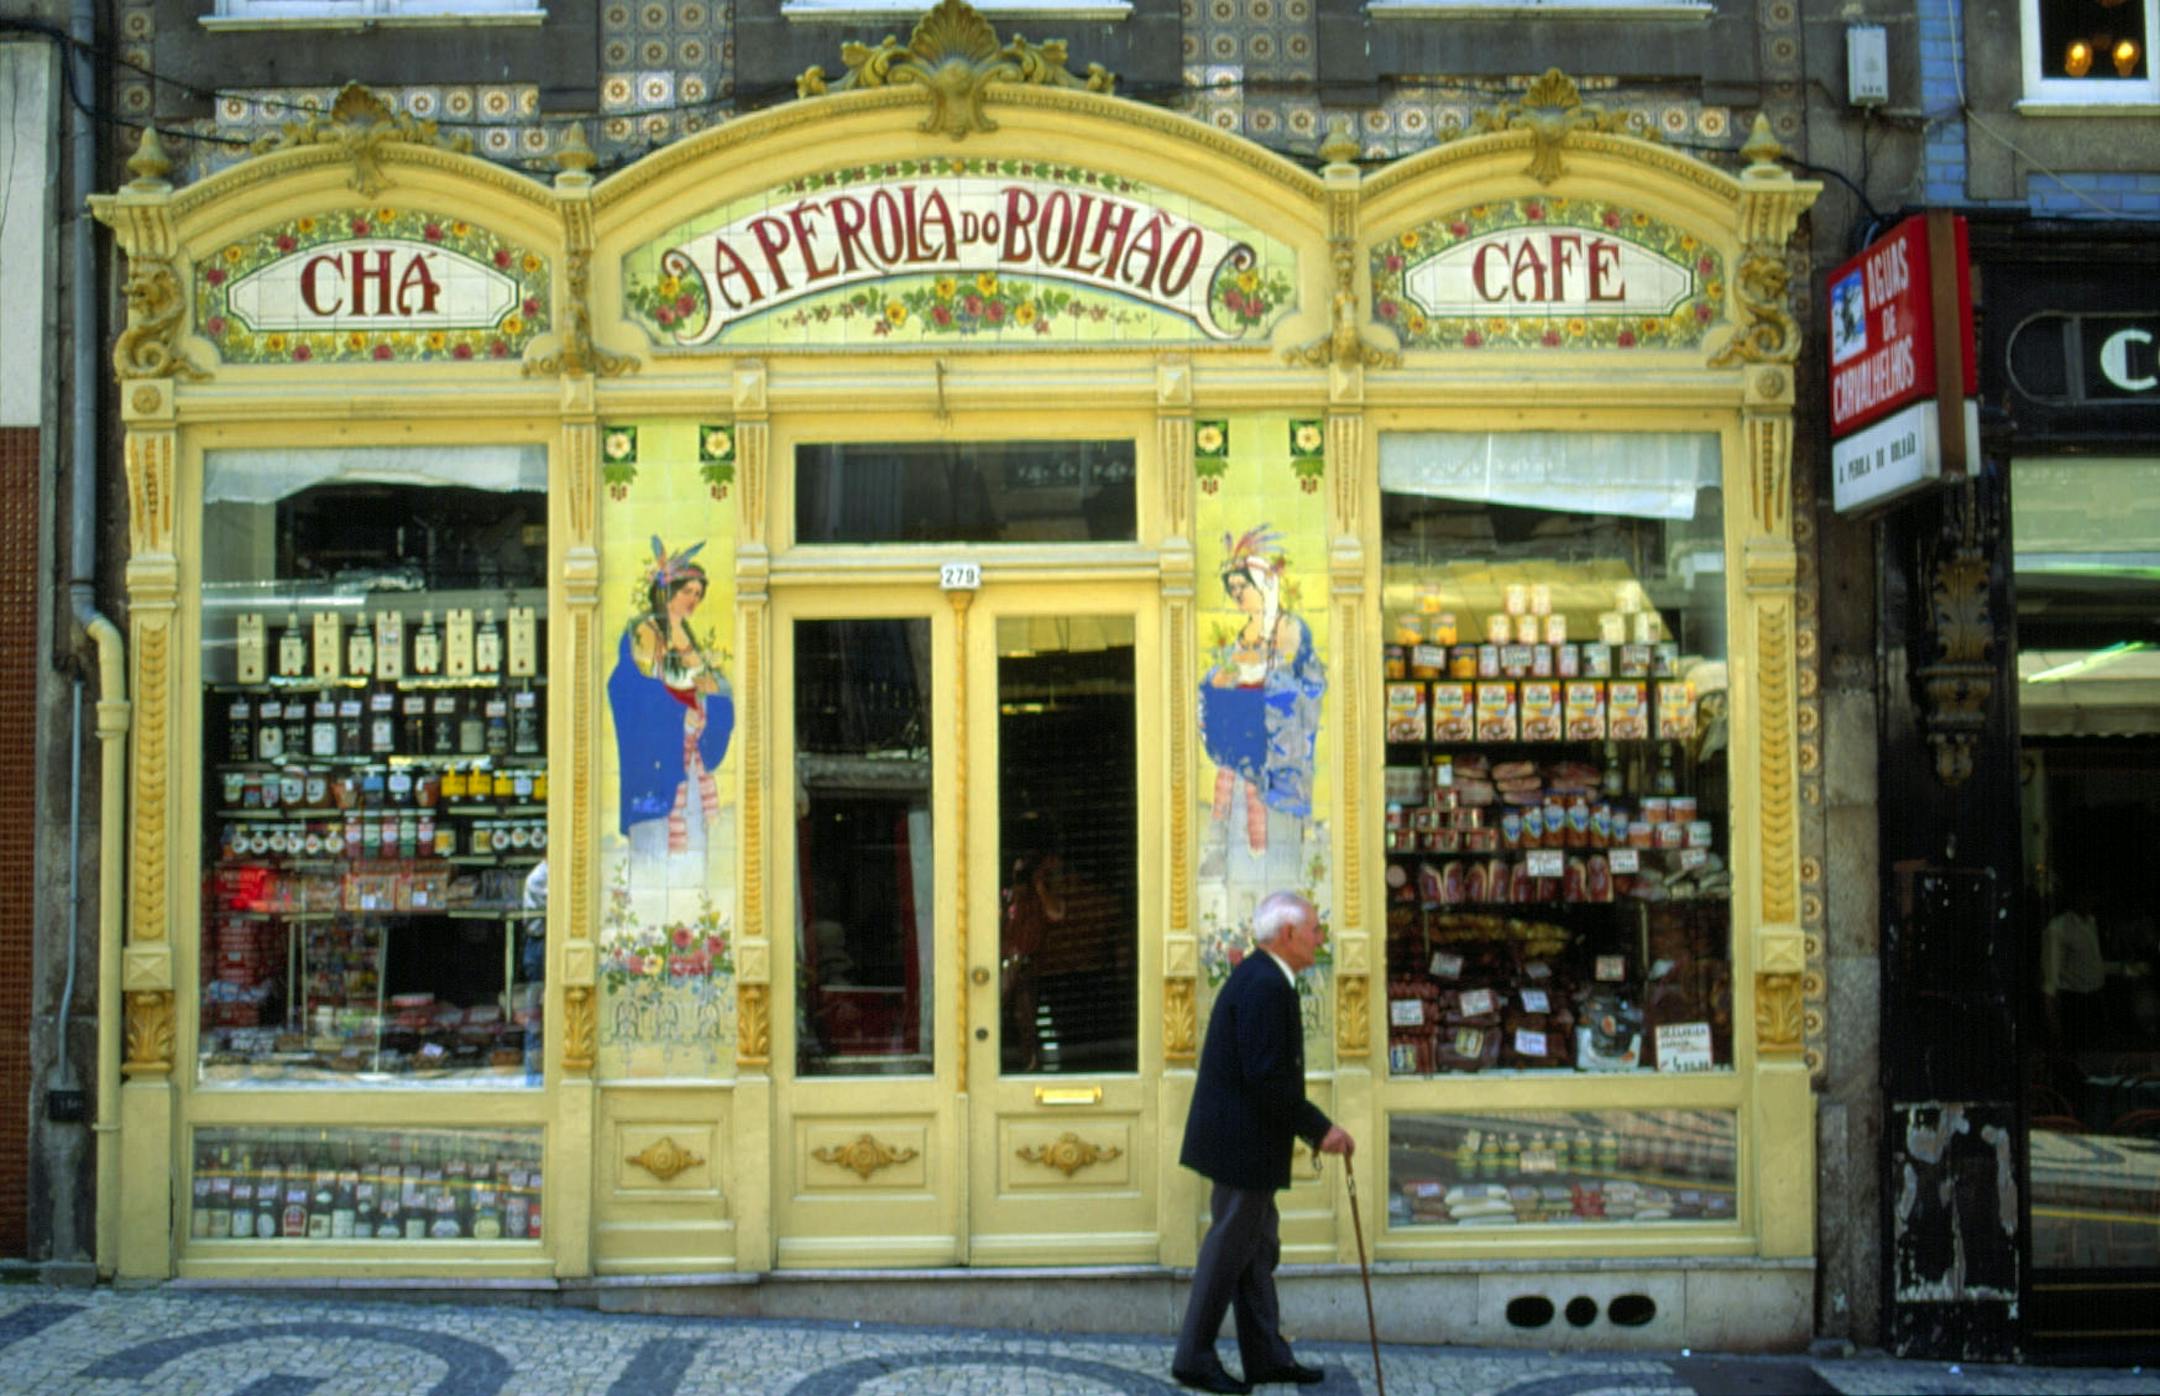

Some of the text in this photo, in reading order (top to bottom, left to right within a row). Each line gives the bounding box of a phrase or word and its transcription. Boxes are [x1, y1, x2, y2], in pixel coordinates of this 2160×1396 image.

[716, 235, 763, 306] A
[1001, 184, 1204, 299] BOLHÃO
[1472, 234, 1626, 303] CAFÉ
[300, 250, 441, 317] CHÁ
[2100, 328, 2160, 391] C
[945, 567, 976, 585] 279
